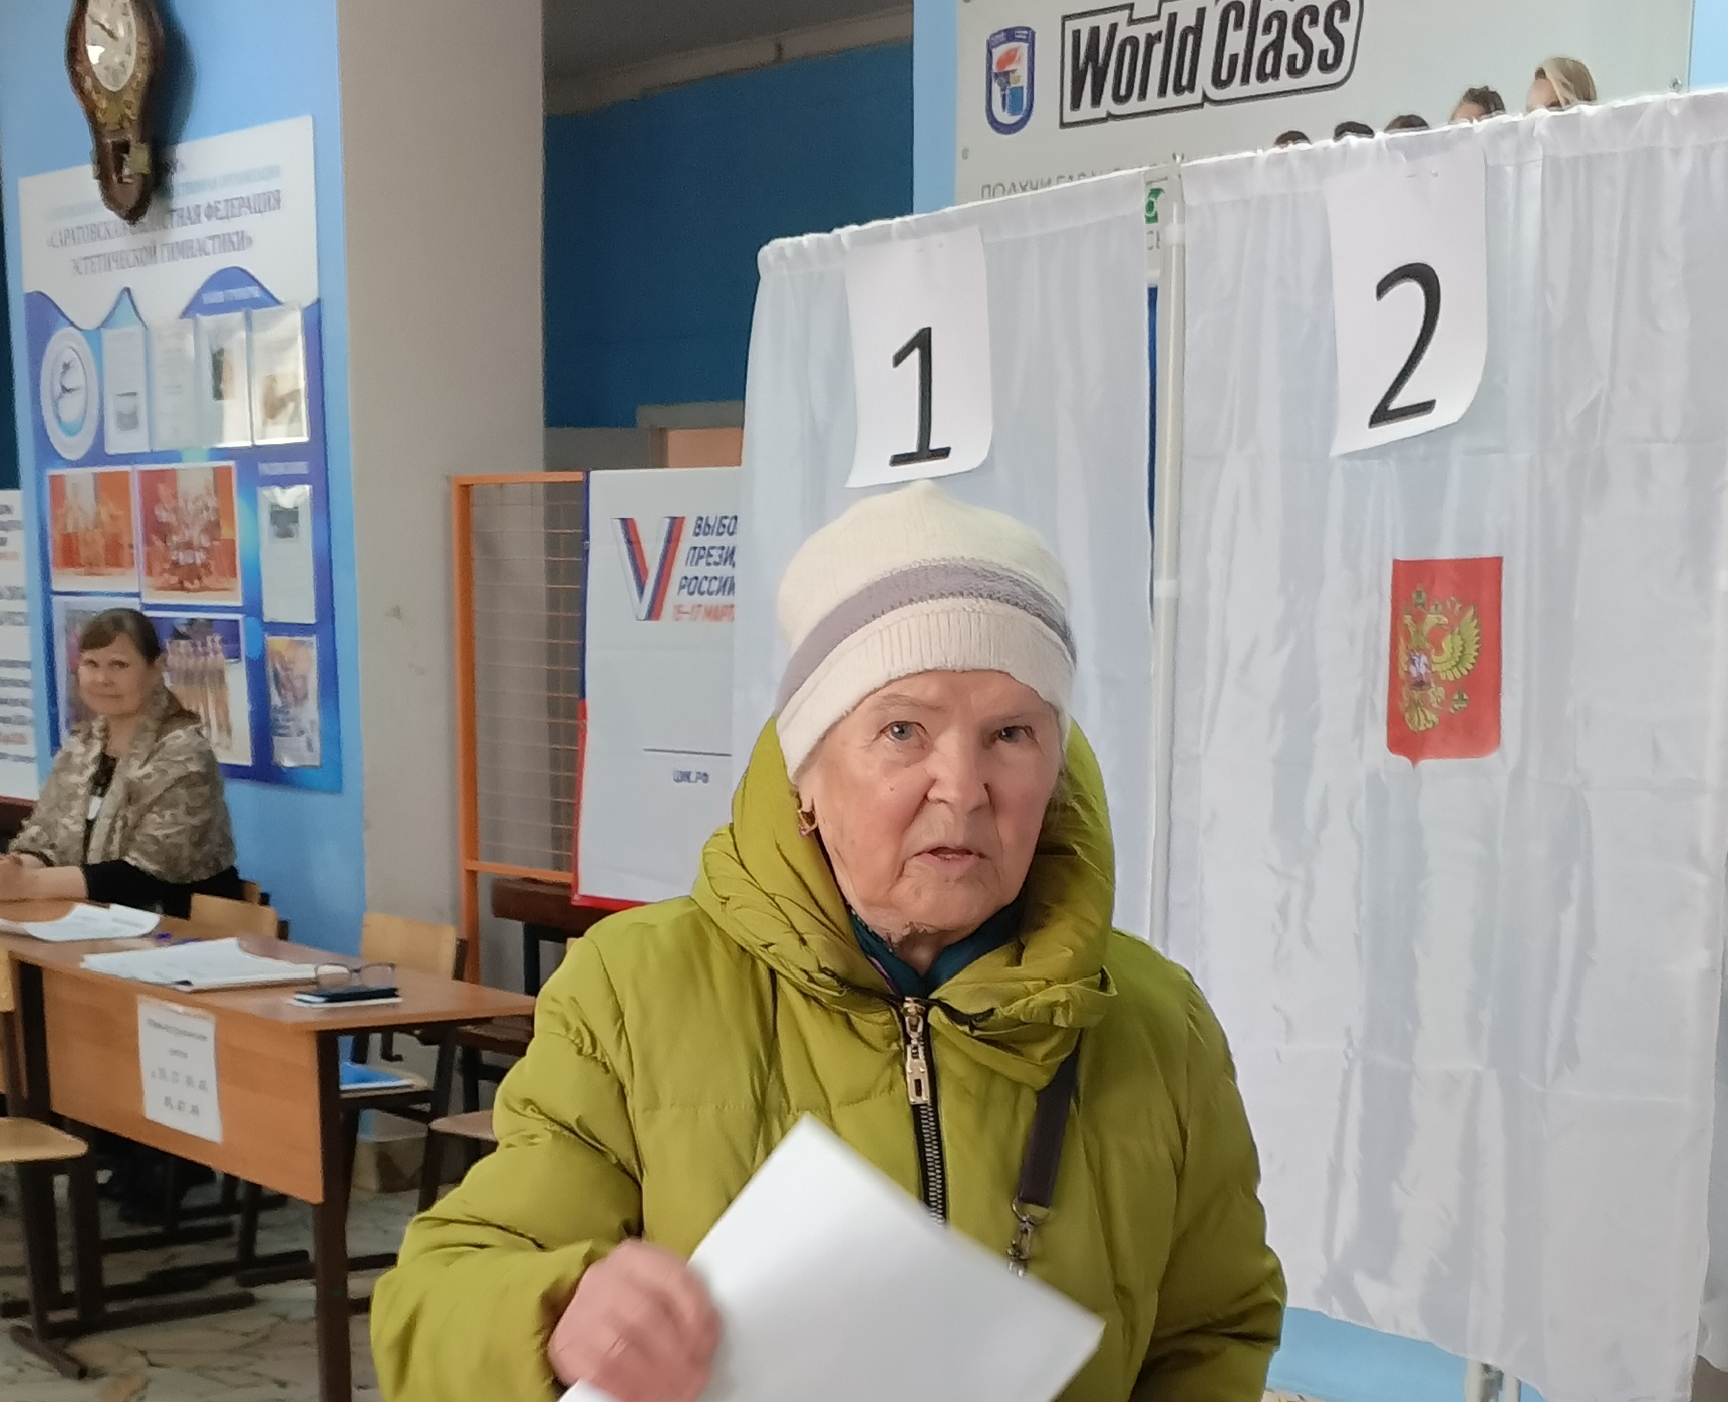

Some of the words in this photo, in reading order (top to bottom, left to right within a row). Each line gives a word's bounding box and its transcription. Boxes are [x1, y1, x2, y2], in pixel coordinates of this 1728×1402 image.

[1070, 7, 1206, 112] World
[1211, 0, 1351, 91] Class
[889, 327, 951, 468] 1
[1368, 261, 1441, 429] 2
[684, 546, 736, 568] ПРЕЗИ
